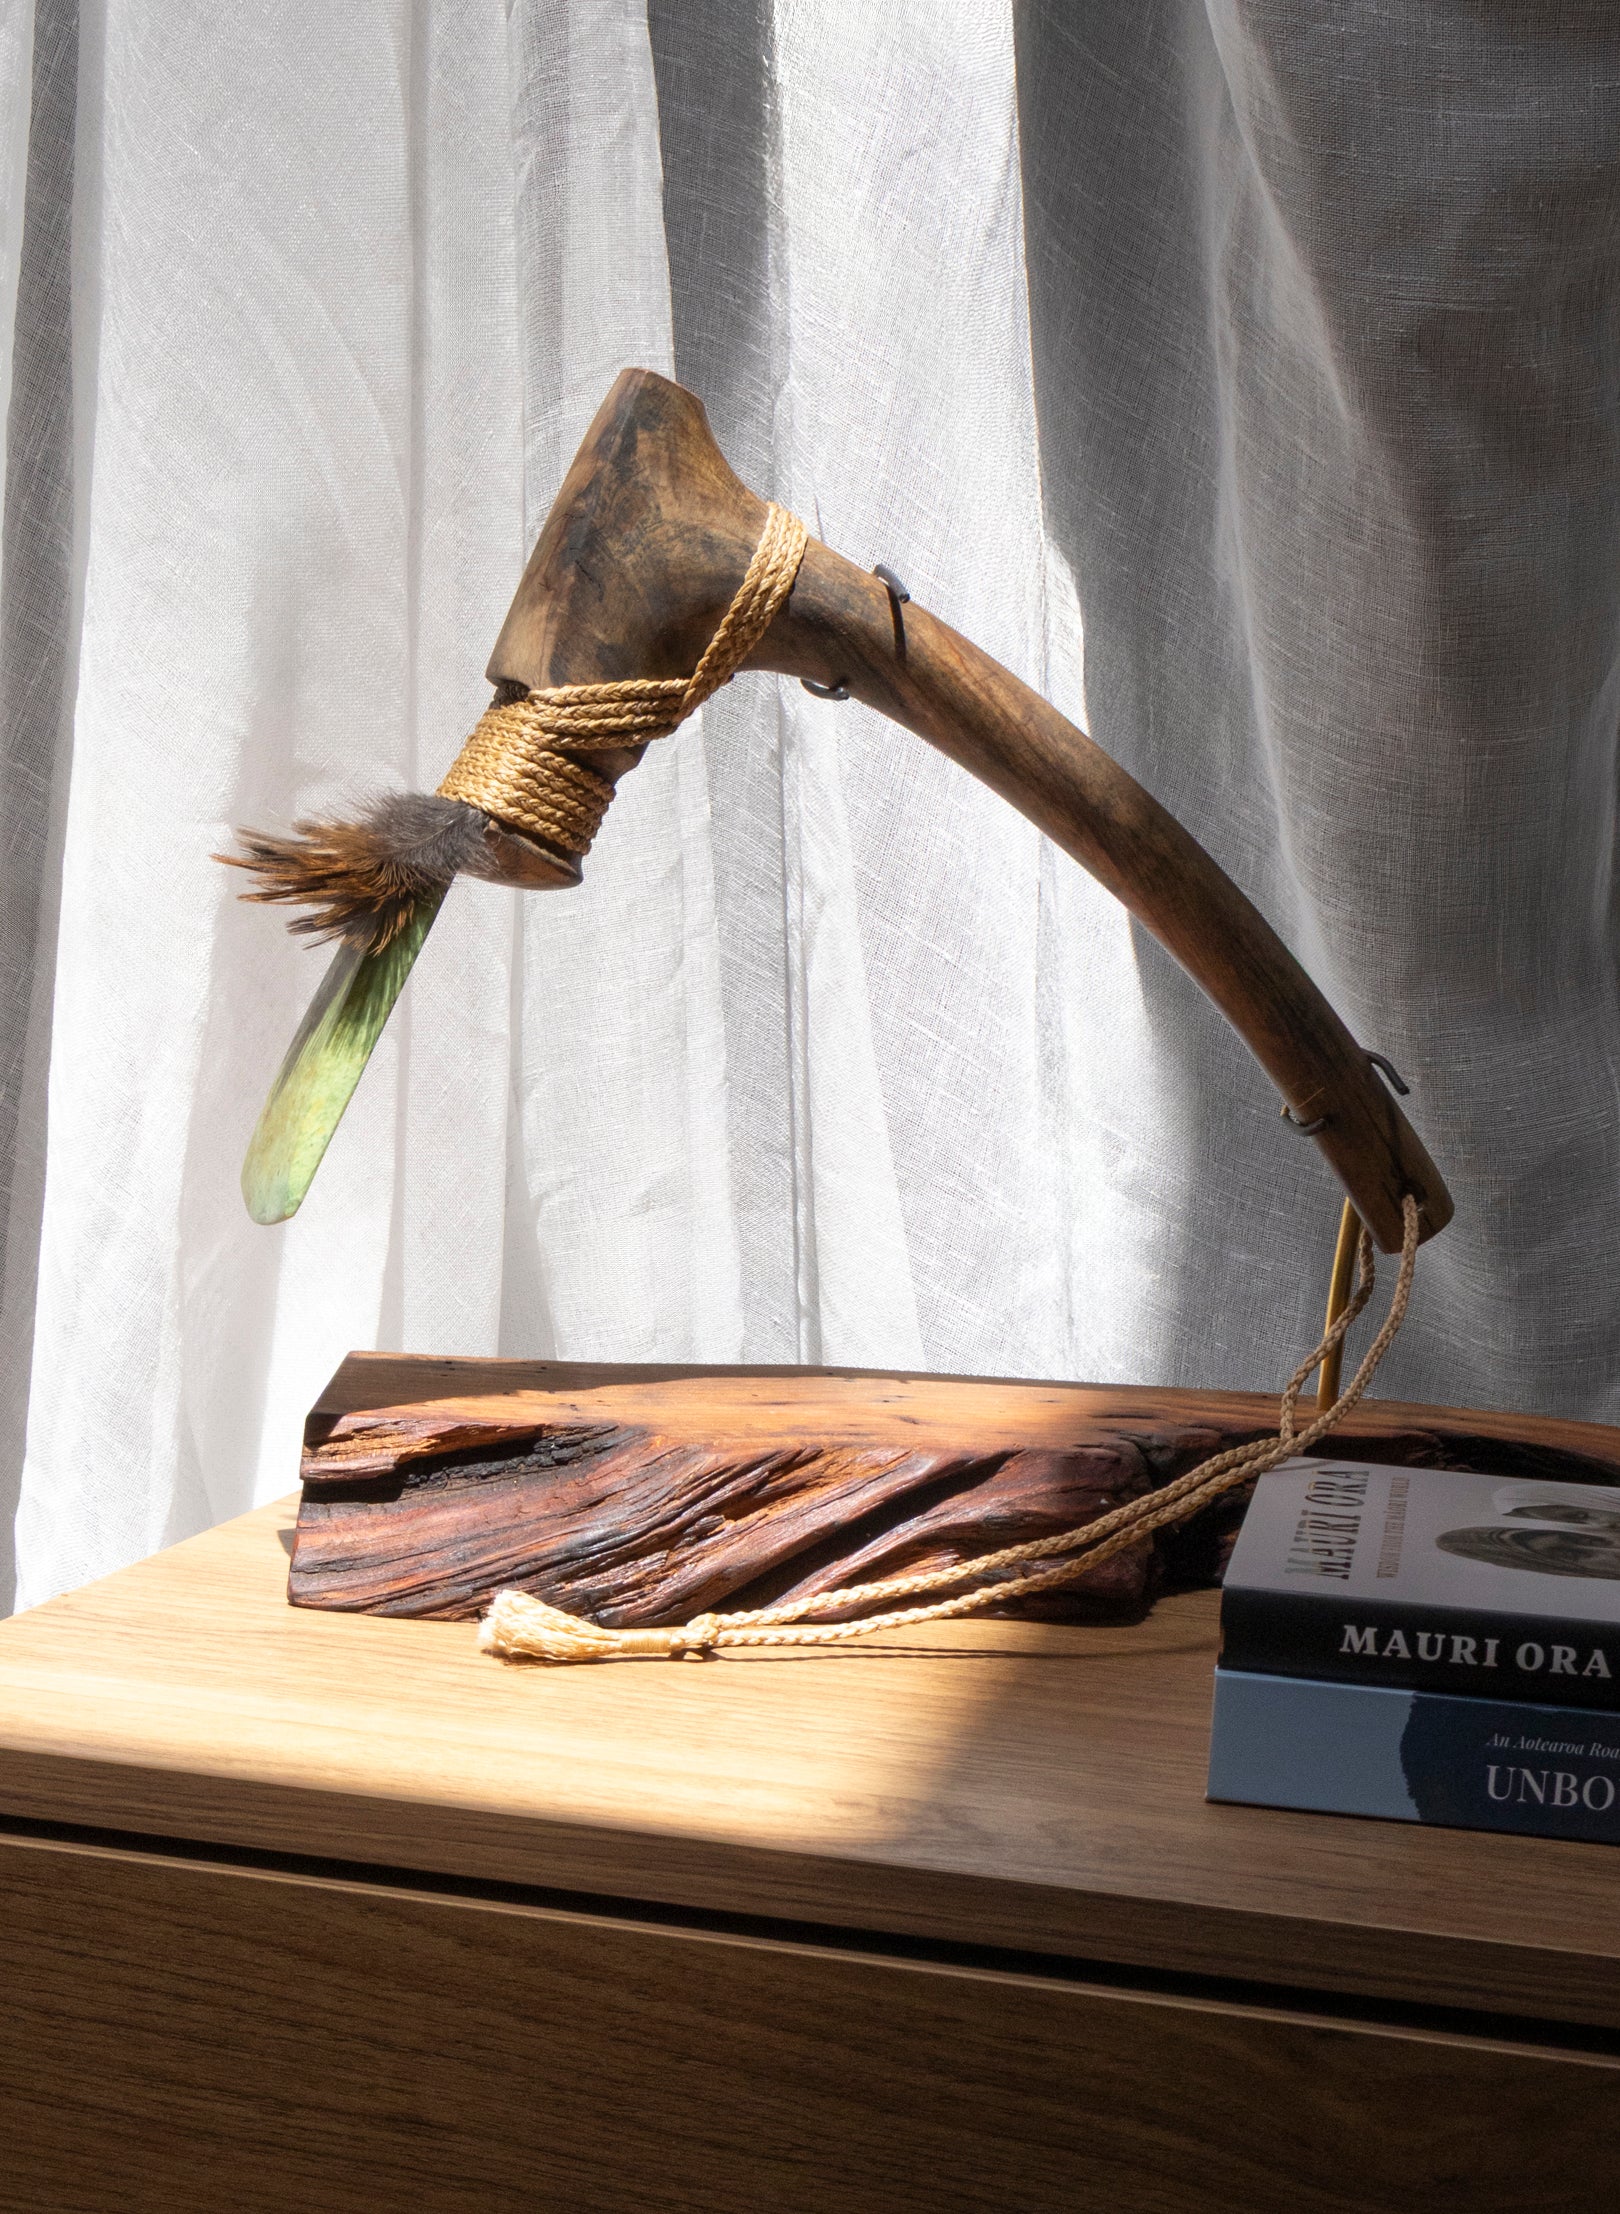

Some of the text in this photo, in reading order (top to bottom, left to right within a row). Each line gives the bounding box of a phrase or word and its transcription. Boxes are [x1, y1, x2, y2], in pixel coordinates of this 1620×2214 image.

[1389, 1477, 1410, 1499] WORLD
[1284, 1471, 1370, 1580] MAURI ORA
[1338, 1624, 1613, 1678] MAURI ORA
[1485, 1732, 1620, 1760] An Aotearoa Roa
[1486, 1764, 1620, 1811] UNBO
